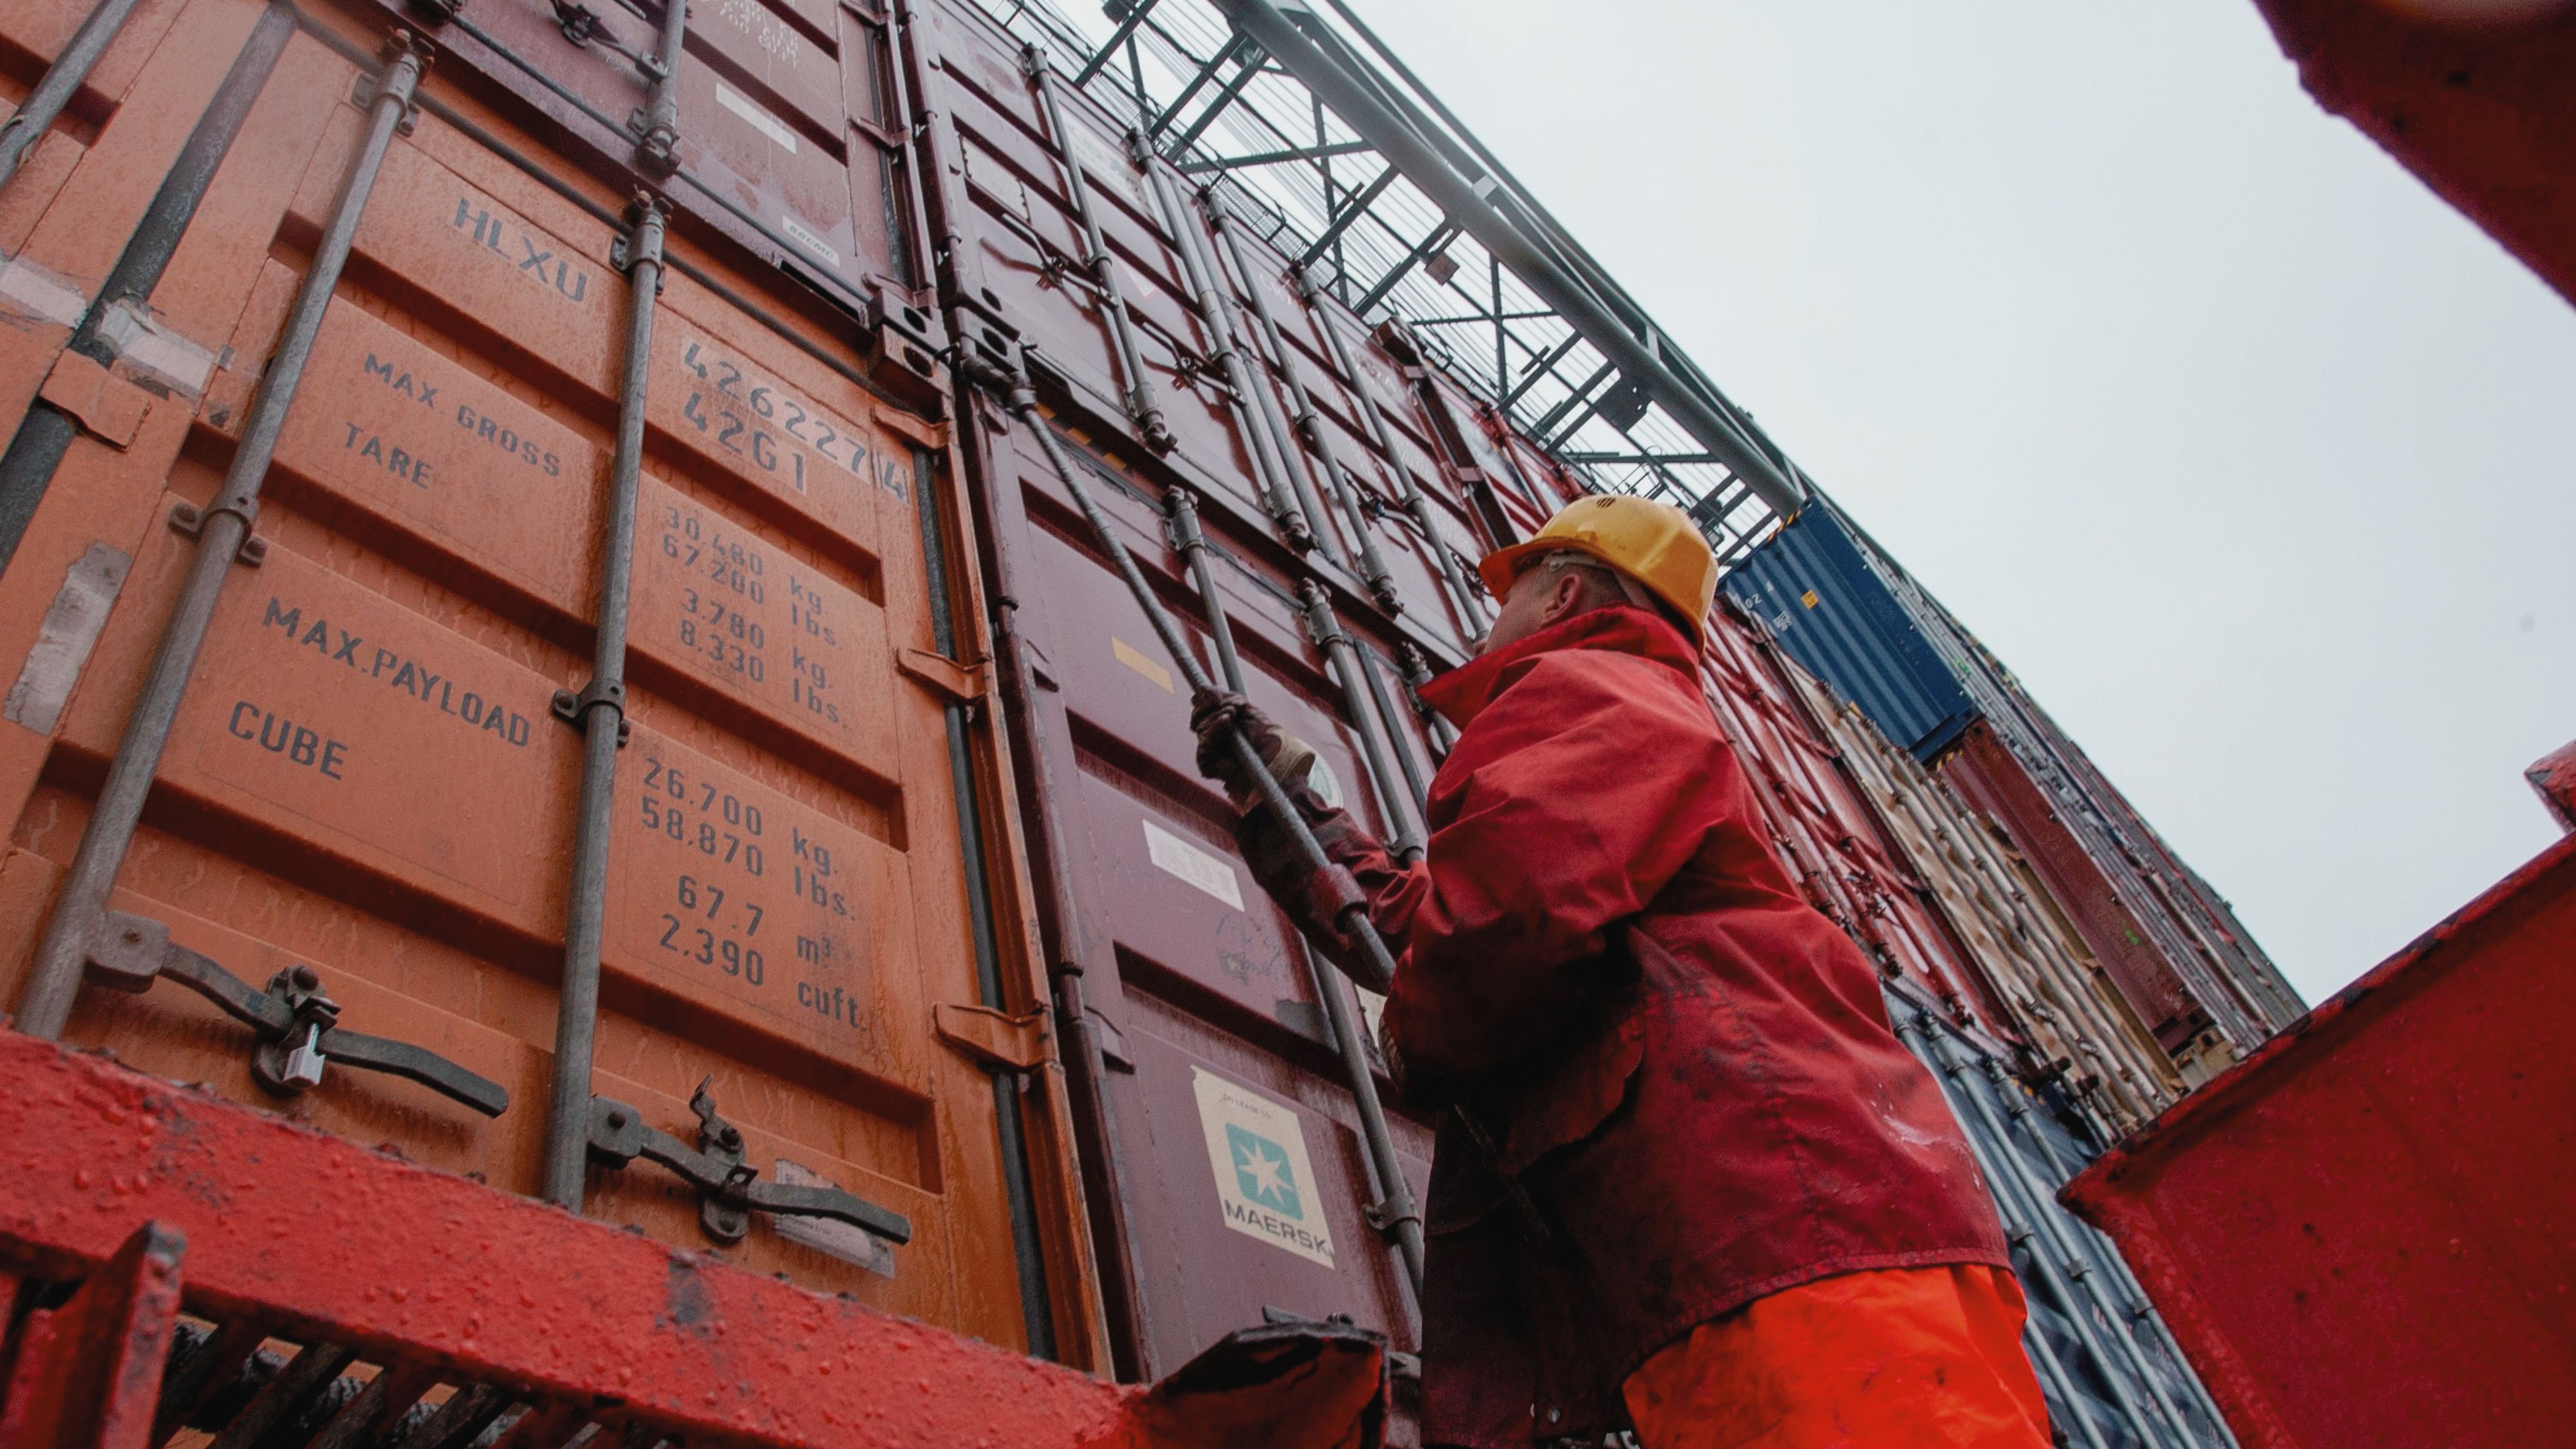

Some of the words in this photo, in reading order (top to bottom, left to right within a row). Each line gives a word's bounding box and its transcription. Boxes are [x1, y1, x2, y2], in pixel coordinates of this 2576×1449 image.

[453, 197, 588, 303] HLXU
[456, 404, 561, 478] GROSS
[683, 342, 867, 473] 426227
[683, 391, 804, 490] 42G1
[345, 422, 433, 490] TARE
[663, 534, 765, 605] 67.200
[665, 506, 764, 576] 30.480
[680, 619, 764, 683] 8.330
[682, 587, 765, 650] 3.780
[228, 701, 348, 781] CUBE
[642, 758, 762, 837] 26.700
[641, 795, 764, 877] 58.870
[677, 875, 764, 936] 67.7
[659, 913, 764, 987] 2.390
[1224, 1199, 1334, 1257] MAERSK
